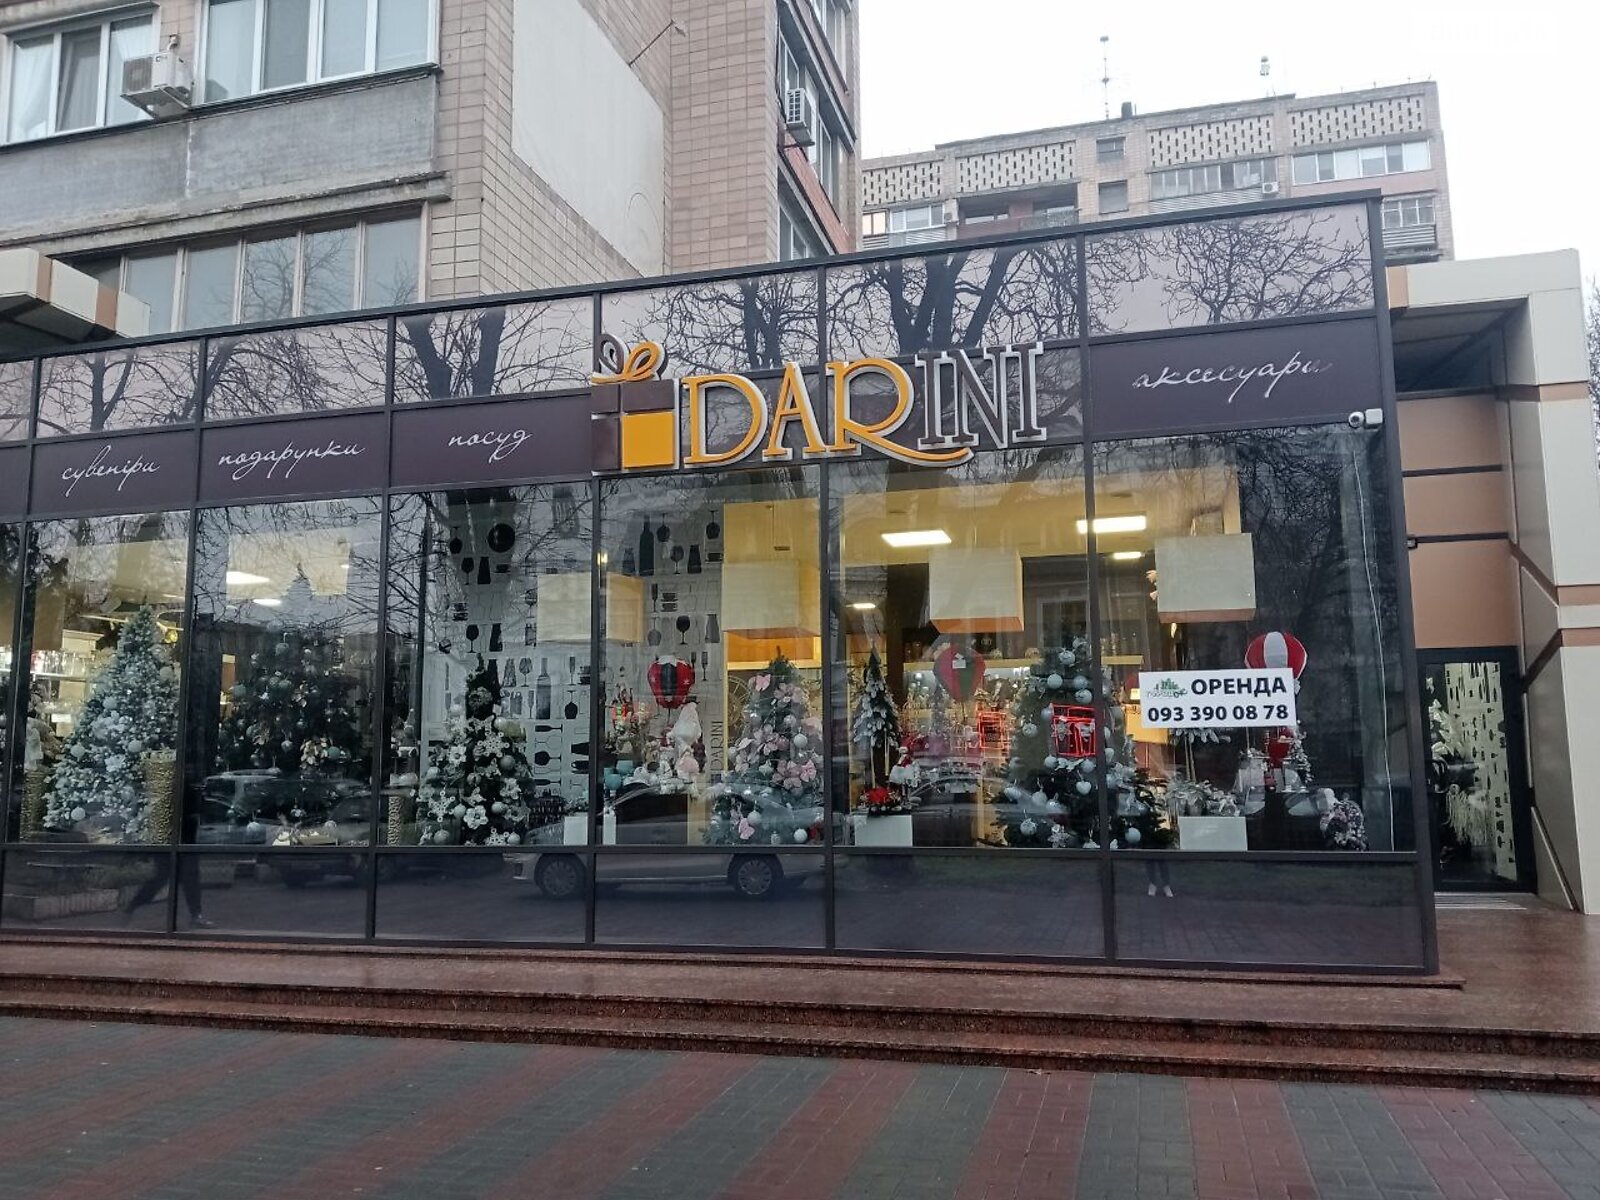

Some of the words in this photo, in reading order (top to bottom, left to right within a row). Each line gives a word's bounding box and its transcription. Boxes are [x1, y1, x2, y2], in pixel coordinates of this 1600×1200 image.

[681, 341, 1047, 468] DARINI
[218, 439, 366, 482] подарунки
[447, 428, 534, 464] посуд
[61, 444, 161, 497] сувеніри
[1191, 677, 1287, 698] ОРЕНДА
[1147, 706, 1185, 722] 093
[1190, 705, 1228, 721] 390
[1232, 704, 1259, 720] 08
[1263, 704, 1290, 720] 78
